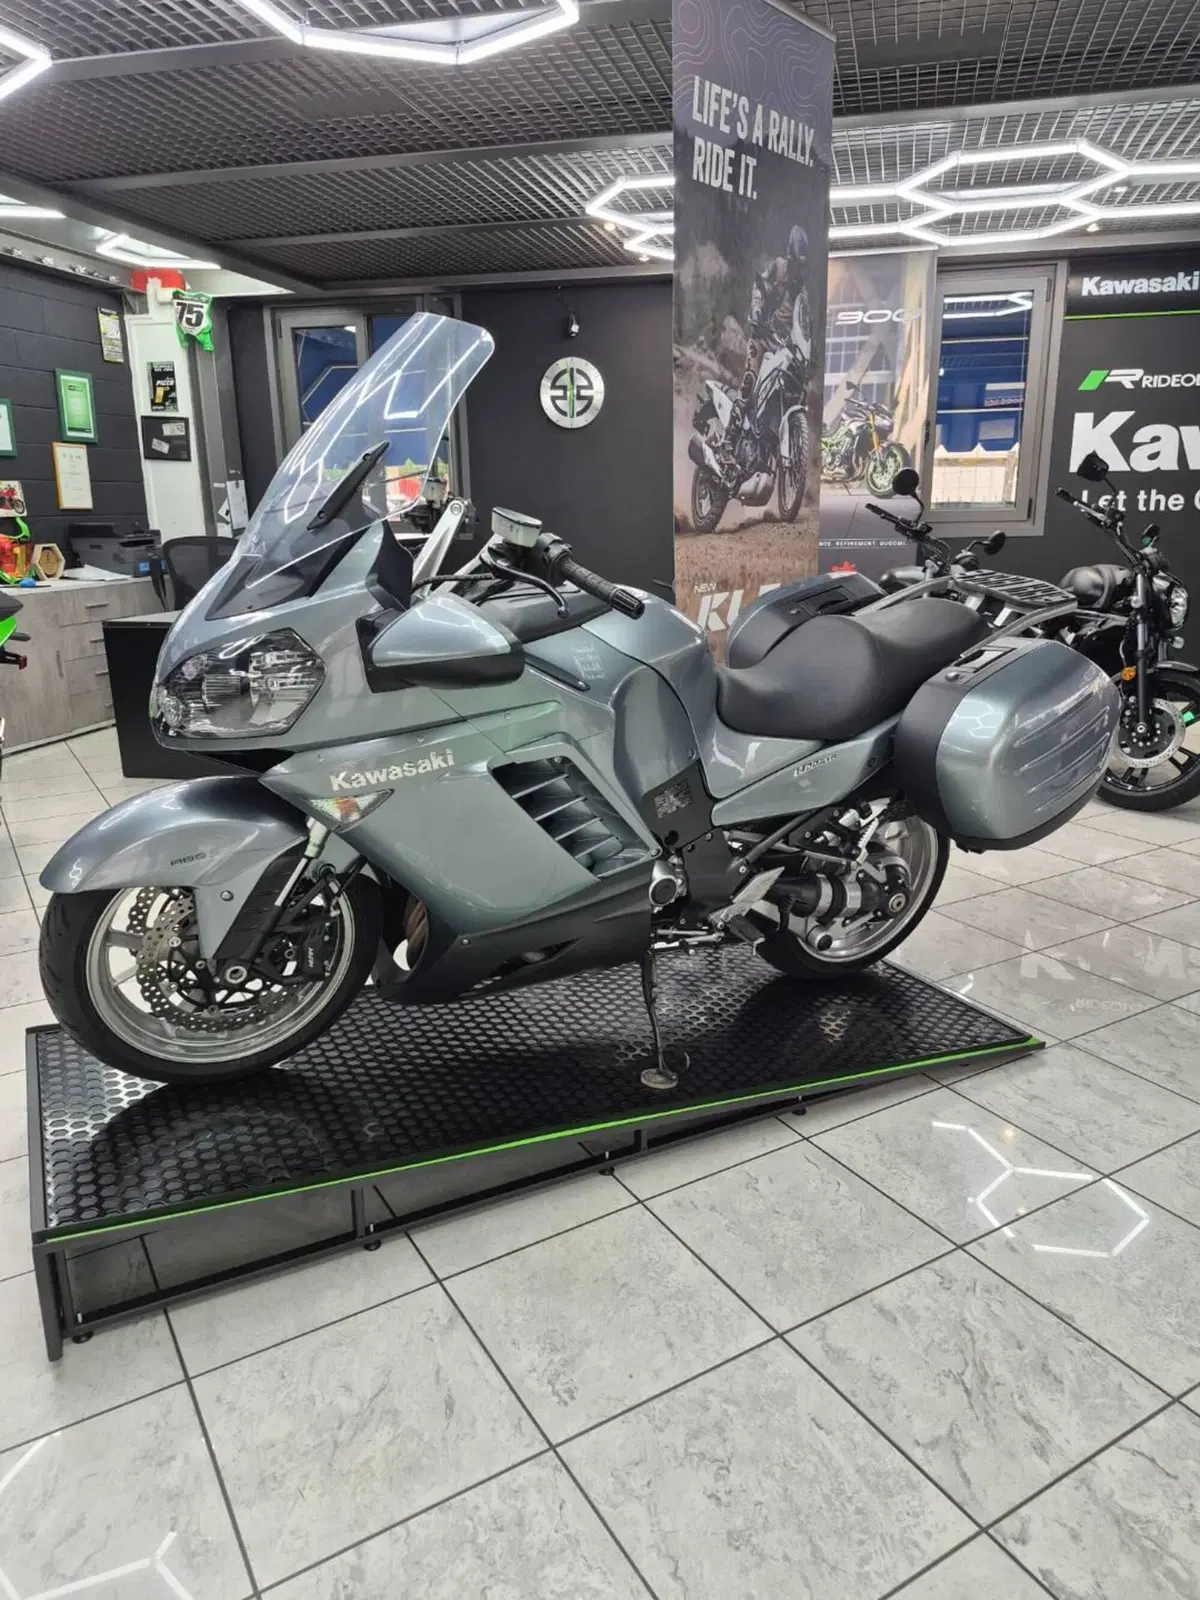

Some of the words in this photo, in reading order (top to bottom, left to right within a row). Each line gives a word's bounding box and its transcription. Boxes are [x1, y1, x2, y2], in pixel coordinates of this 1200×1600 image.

[692, 75, 749, 140] LIFE'S
[751, 104, 764, 145] A
[767, 109, 816, 168] RALLY.
[692, 136, 734, 193] RIDE
[738, 154, 758, 200] IT.
[1081, 271, 1200, 297] Kawasaki
[176, 302, 204, 327] 75
[1137, 489, 1185, 512] the
[328, 748, 456, 792] Kawasaki
